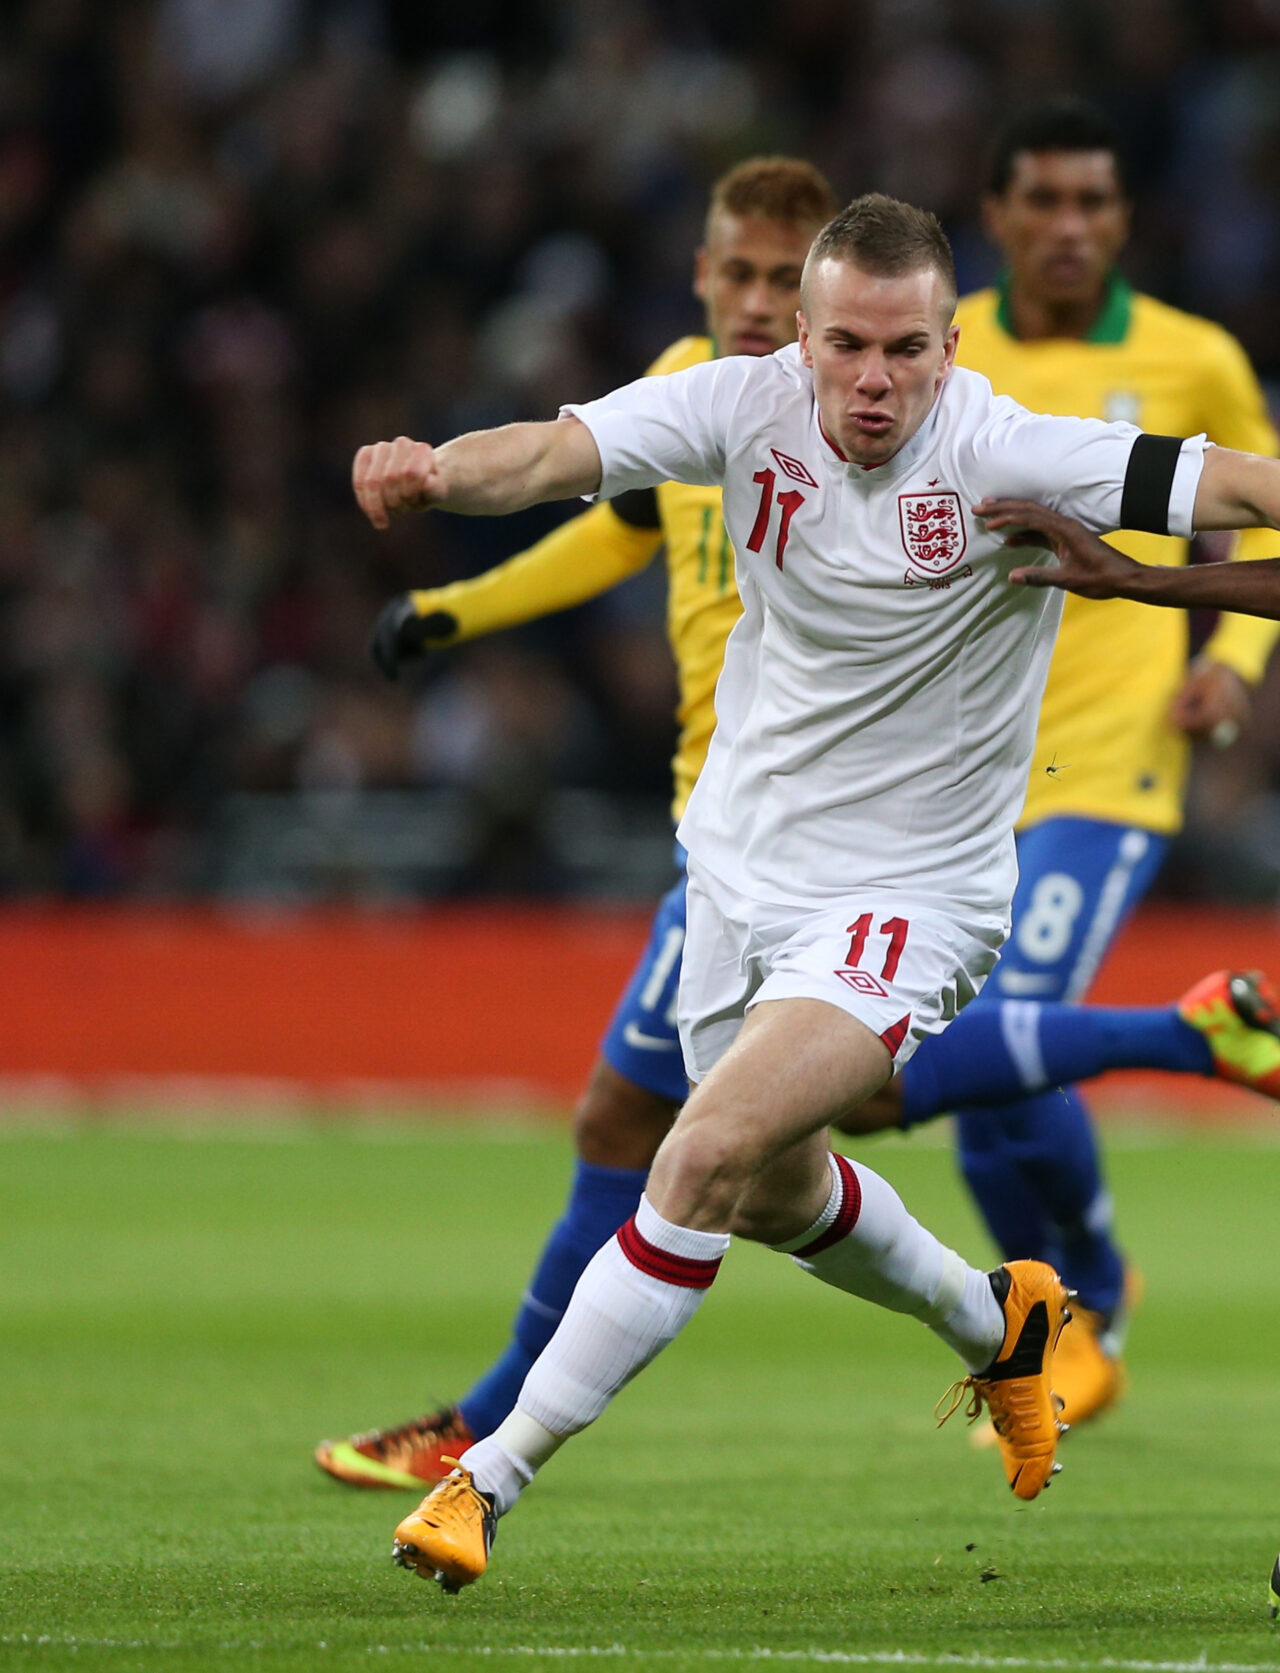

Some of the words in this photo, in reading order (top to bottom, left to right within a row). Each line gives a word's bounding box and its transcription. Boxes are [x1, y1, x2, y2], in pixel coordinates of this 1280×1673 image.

[746, 468, 806, 571] 11
[845, 912, 909, 983] 11
[1016, 872, 1084, 964] 8
[641, 926, 686, 1027] 1
